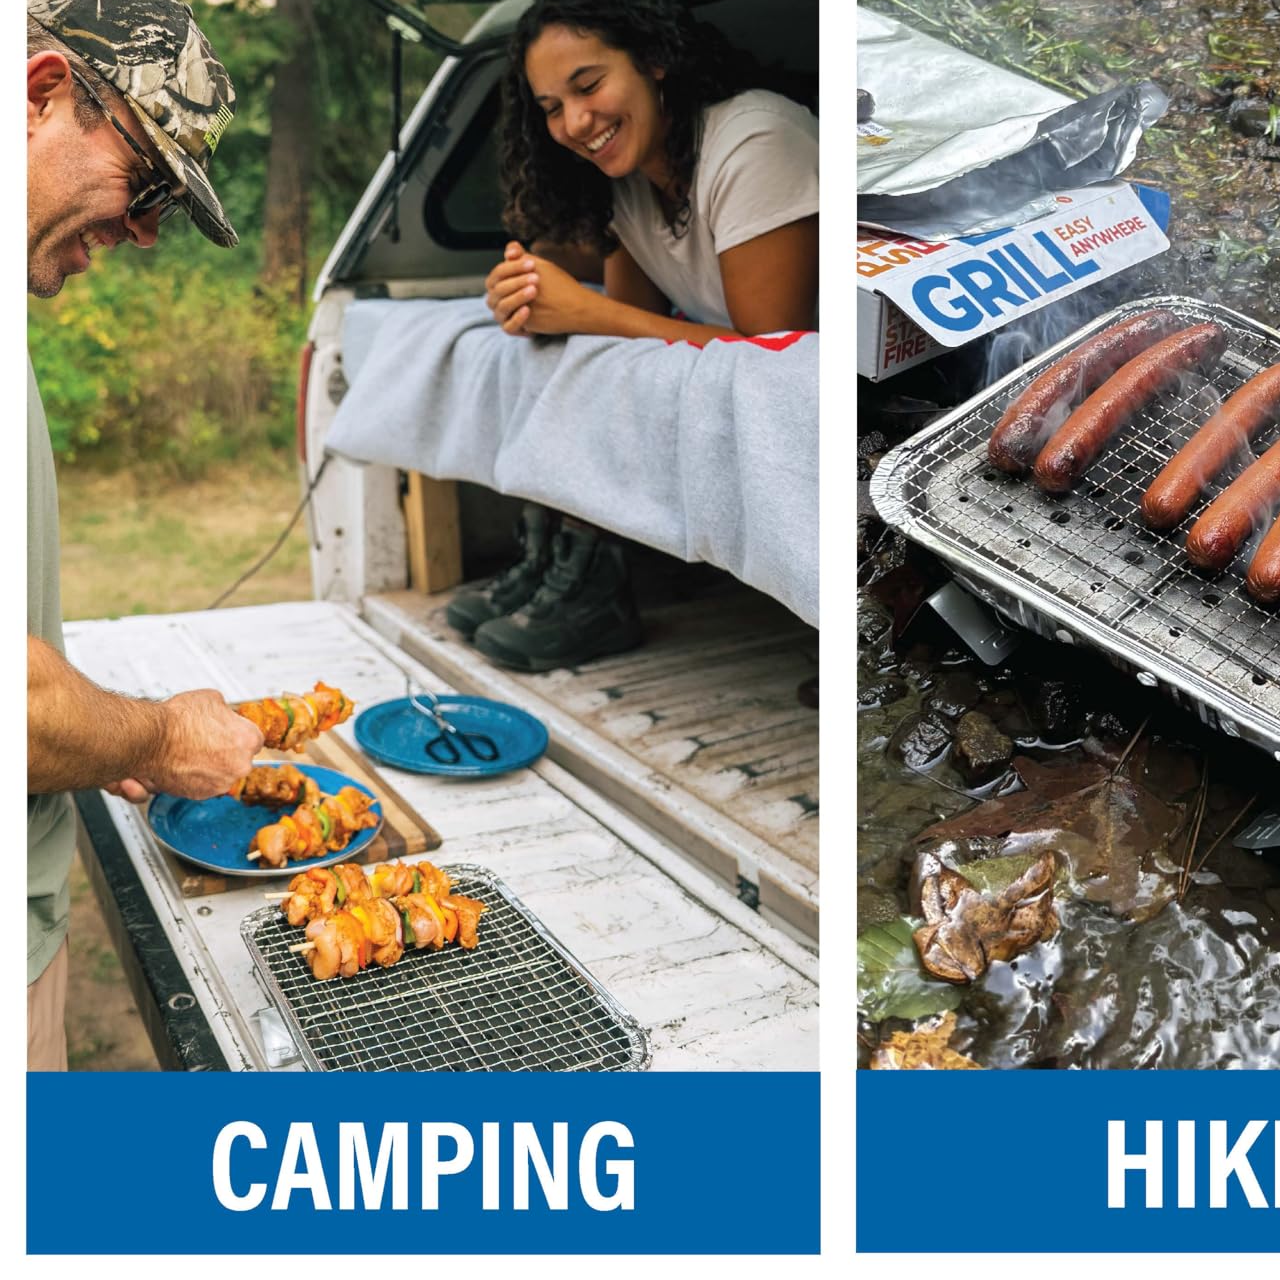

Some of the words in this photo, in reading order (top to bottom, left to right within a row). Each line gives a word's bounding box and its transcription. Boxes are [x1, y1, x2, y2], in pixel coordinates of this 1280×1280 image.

[1054, 216, 1094, 242] EASY
[1069, 216, 1147, 257] ANYWHERE
[911, 230, 1102, 332] GRILL
[884, 333, 926, 369] FIRE
